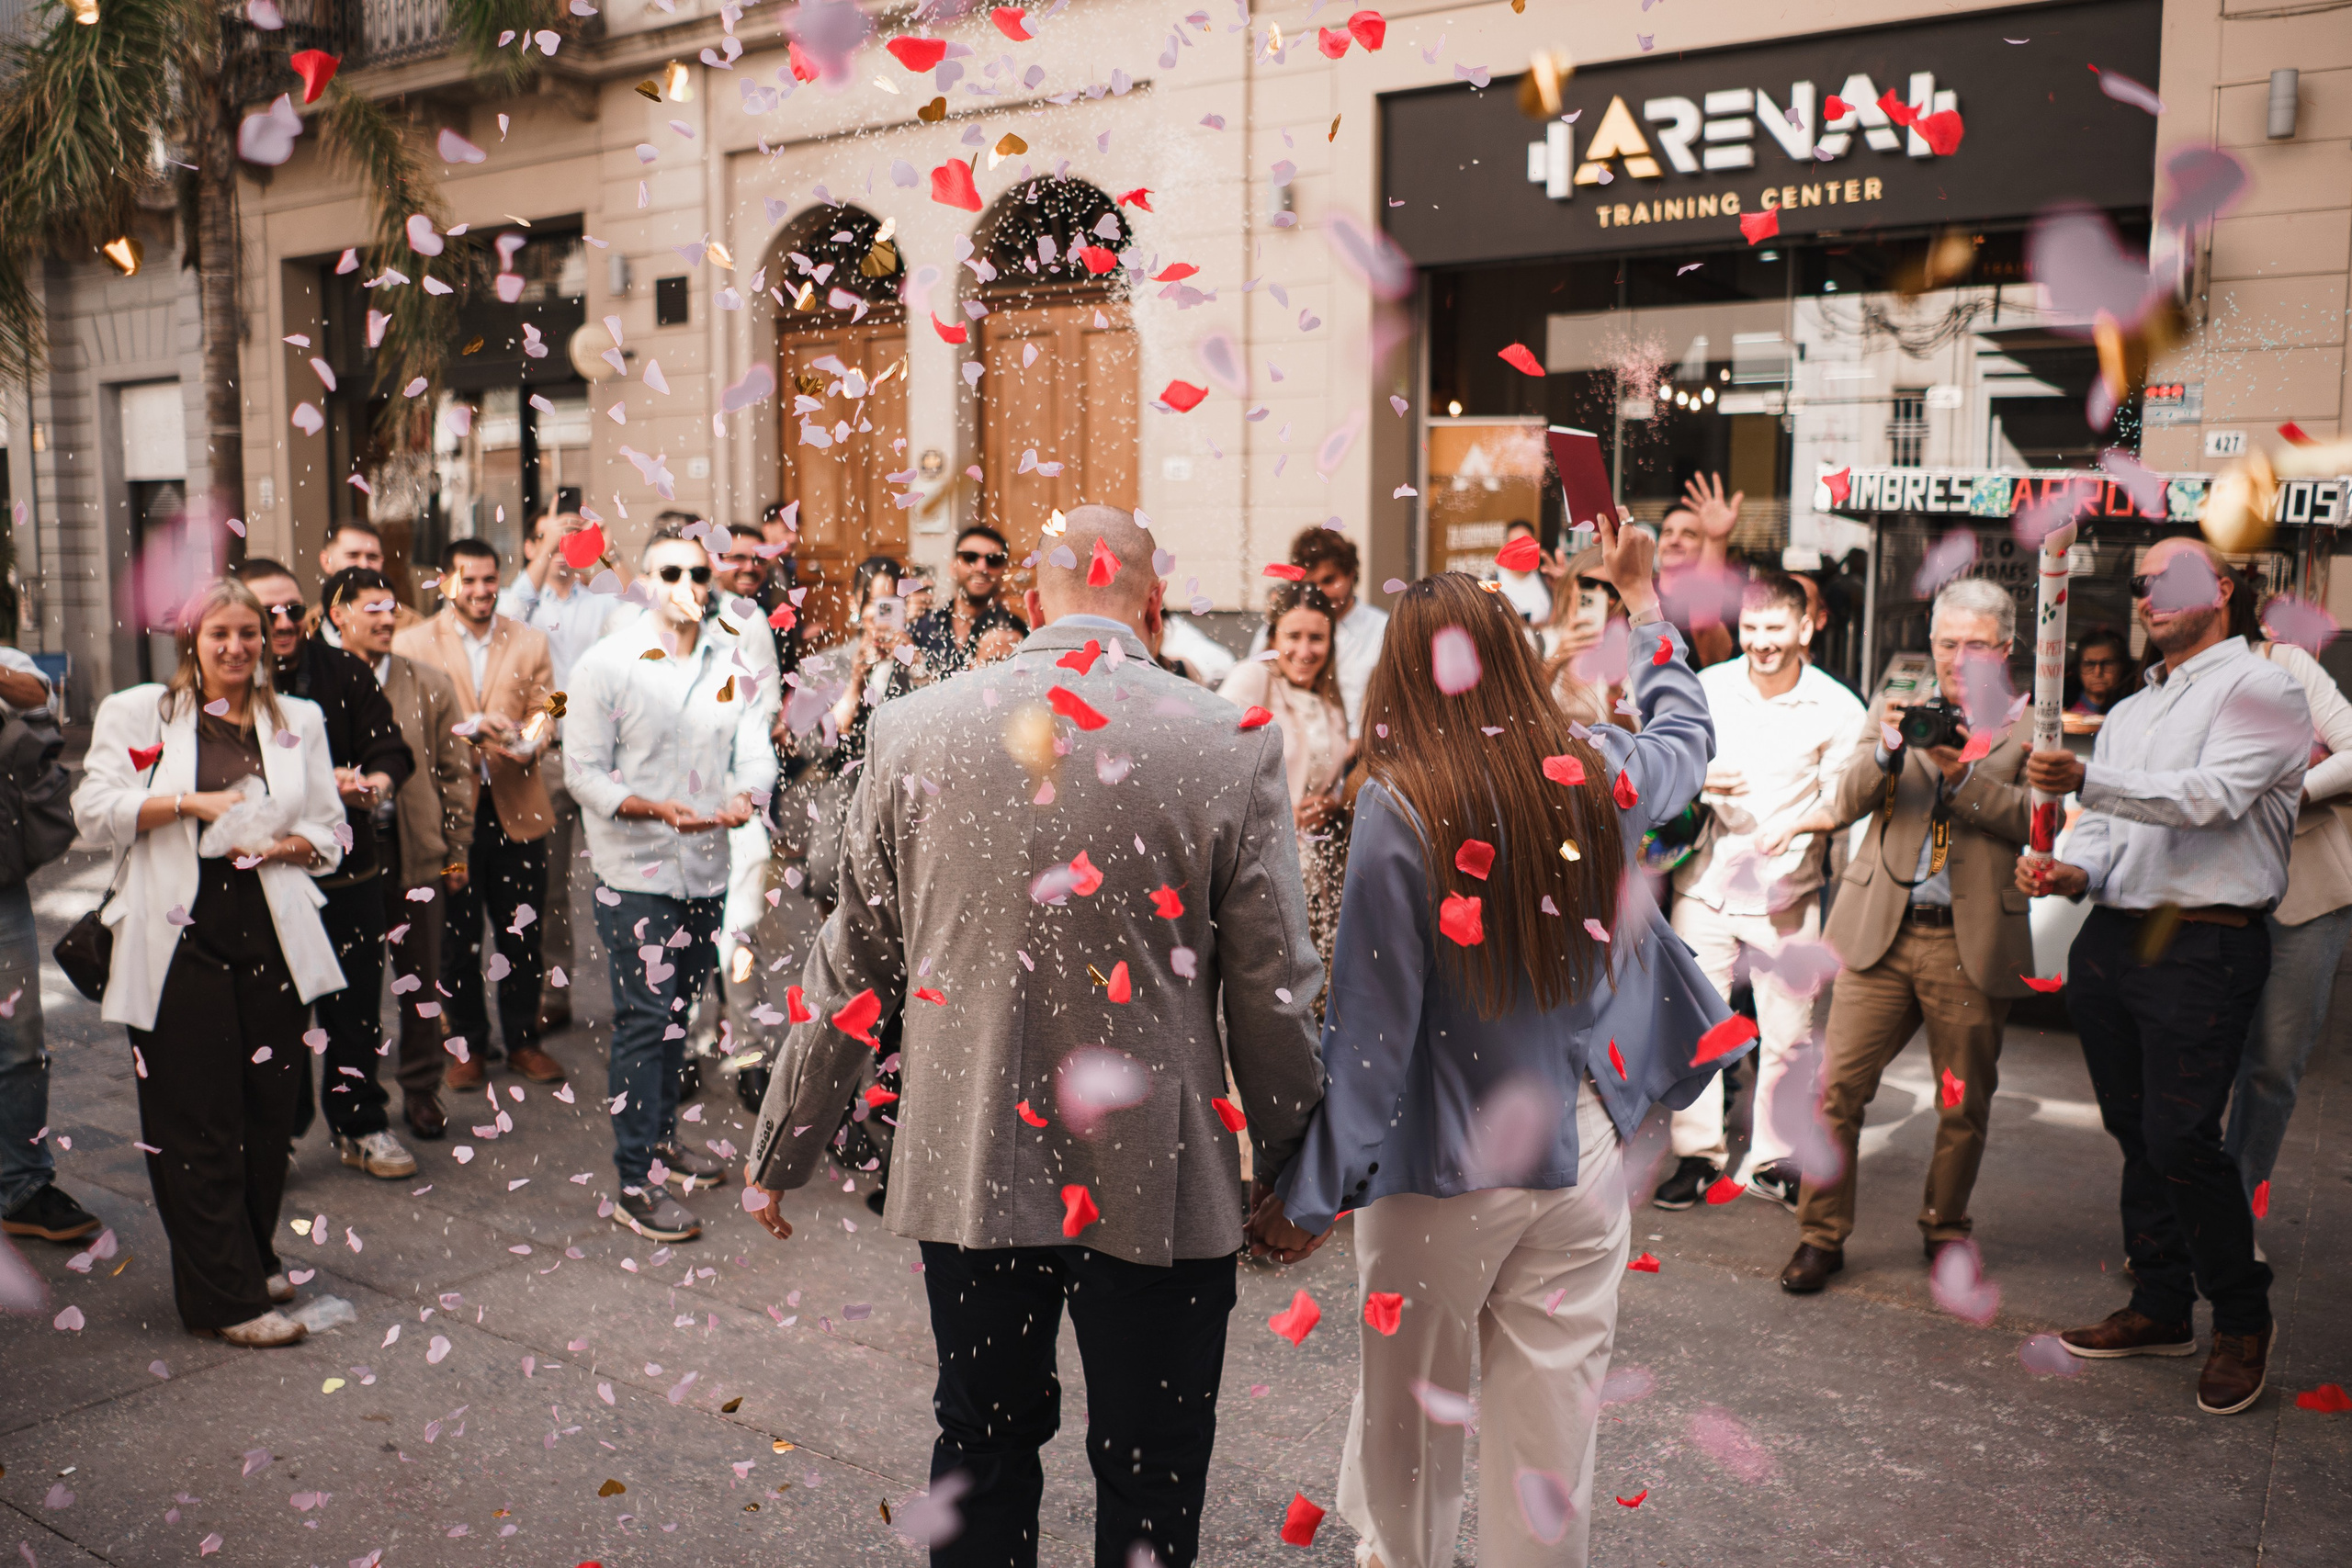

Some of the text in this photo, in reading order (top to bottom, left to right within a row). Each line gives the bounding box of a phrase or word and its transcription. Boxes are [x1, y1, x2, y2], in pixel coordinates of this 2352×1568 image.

[1574, 73, 1901, 186] ARENA
[1596, 175, 1883, 229] TRAINING CENTER
[2214, 435, 2240, 452] 427
[1831, 474, 1973, 513] IMBRES
